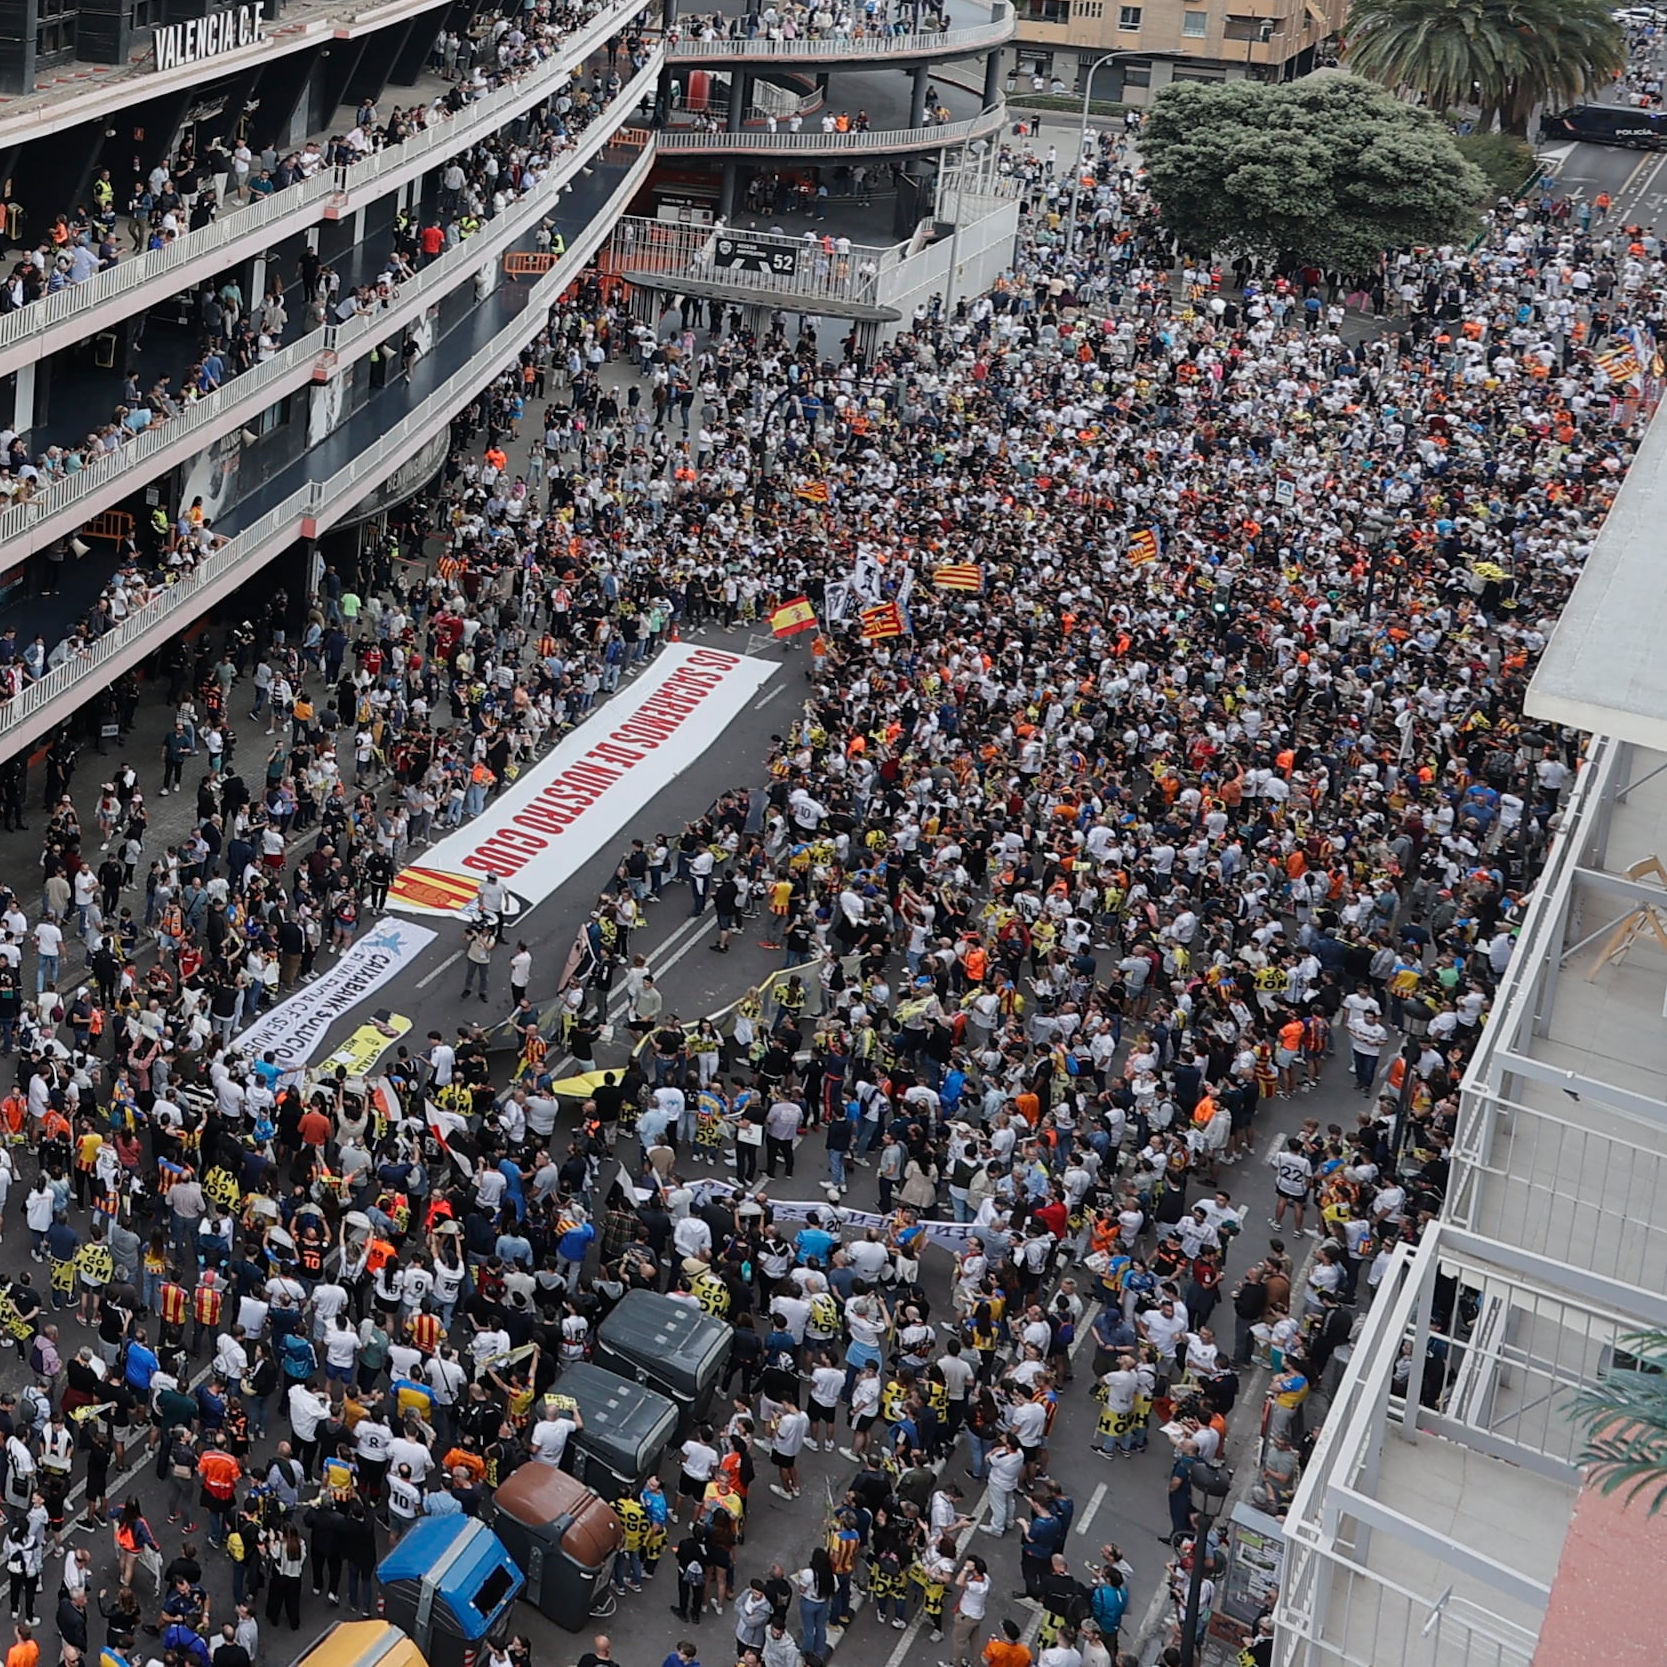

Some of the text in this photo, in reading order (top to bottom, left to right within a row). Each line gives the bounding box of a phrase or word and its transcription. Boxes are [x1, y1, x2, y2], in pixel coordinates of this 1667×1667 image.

[154, 1, 265, 71] VALENCIA C.F.
[773, 254, 793, 271] 52
[462, 649, 741, 877] OS SACAREMOS DE NUESTRO CLUB
[323, 954, 390, 1012] CAIXABANK
[267, 1016, 289, 1032] SE
[1281, 1166, 1305, 1183] 22
[826, 1220, 841, 1233] 20
[87, 1256, 105, 1266] GO
[303, 1256, 320, 1270] 10
[415, 1280, 423, 1294] 9
[701, 1290, 723, 1303] GO
[369, 1436, 379, 1448] 8
[393, 1490, 409, 1510] 10
